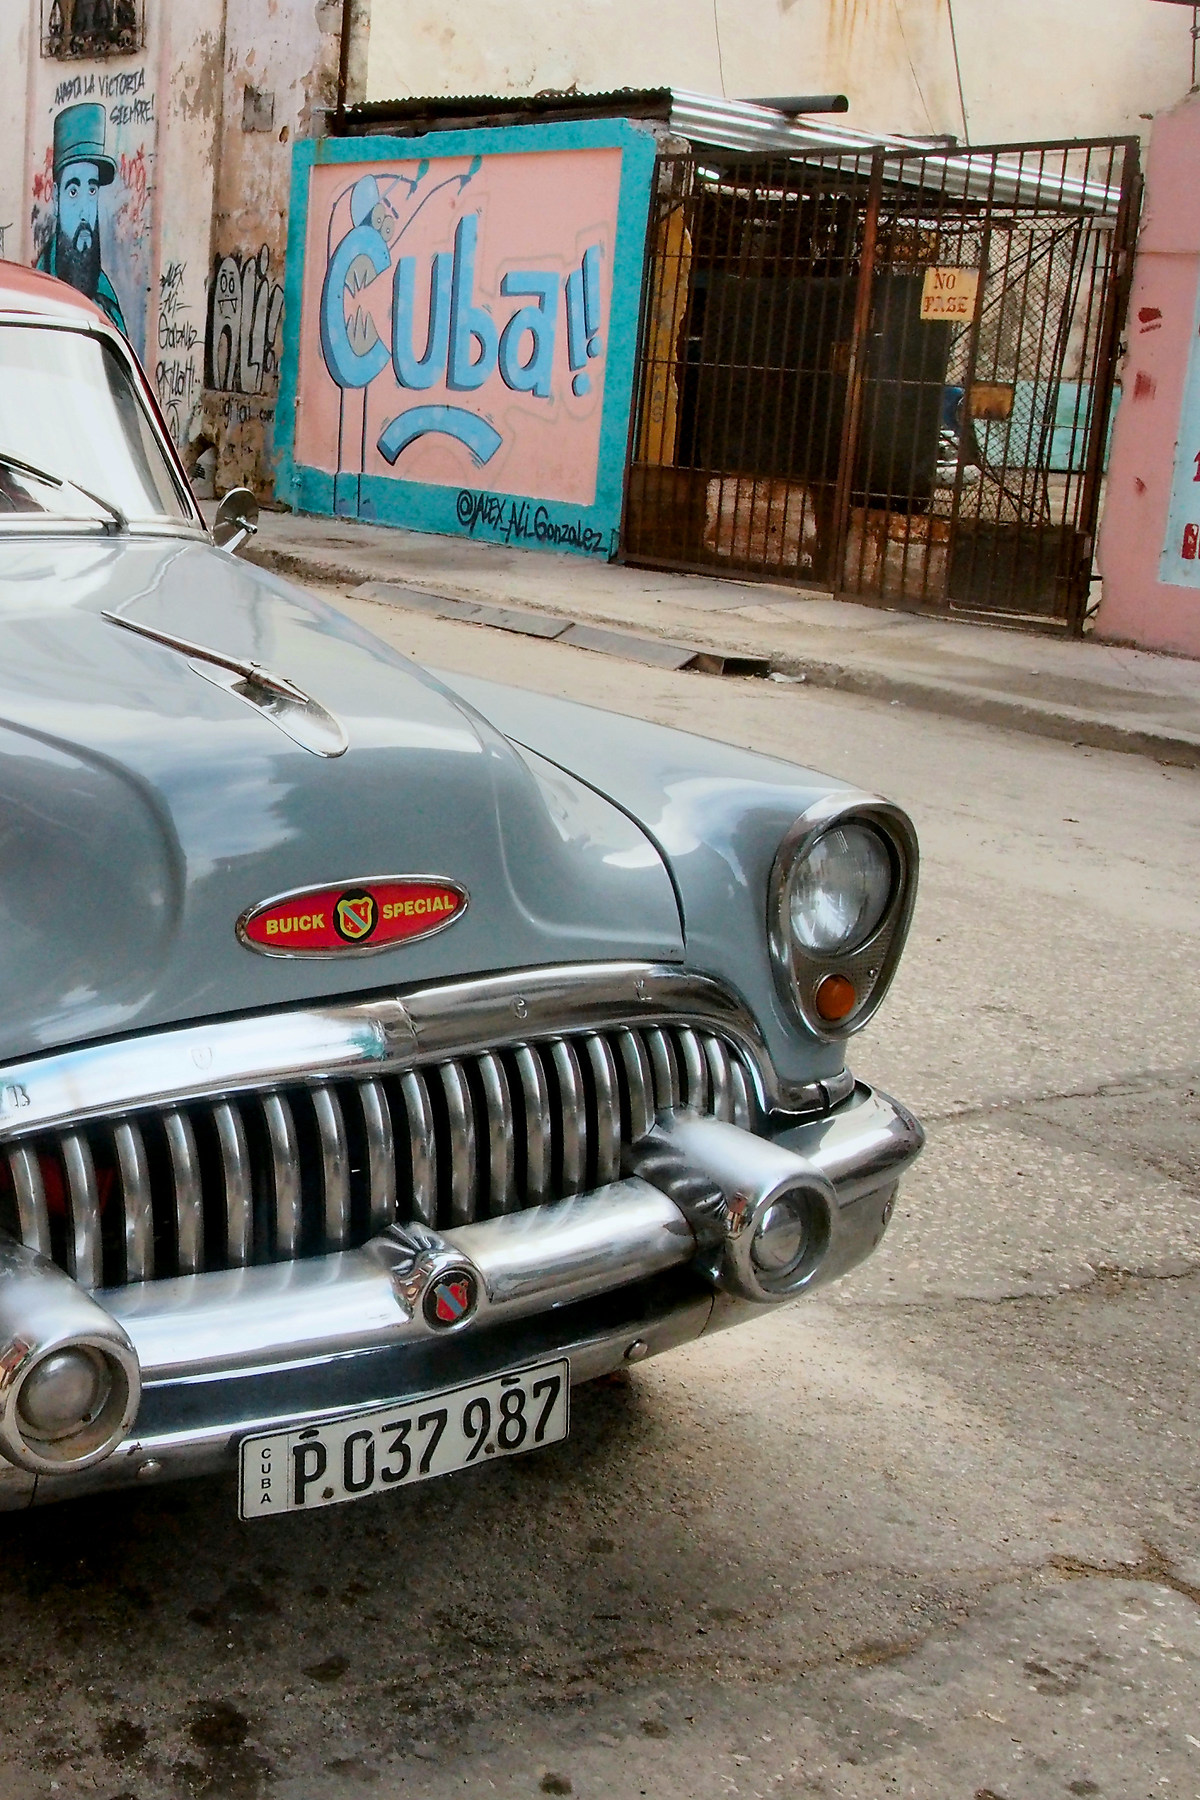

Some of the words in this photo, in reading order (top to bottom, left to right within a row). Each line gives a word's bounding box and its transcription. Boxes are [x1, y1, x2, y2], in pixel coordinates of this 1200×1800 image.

[84, 73, 96, 96] LA
[933, 273, 956, 290] NO
[266, 913, 326, 936] BUICK
[382, 895, 454, 920] SPECIAL
[343, 1408, 449, 1493] 037
[462, 1375, 561, 1463] 987
[259, 1447, 273, 1505] CUBA
